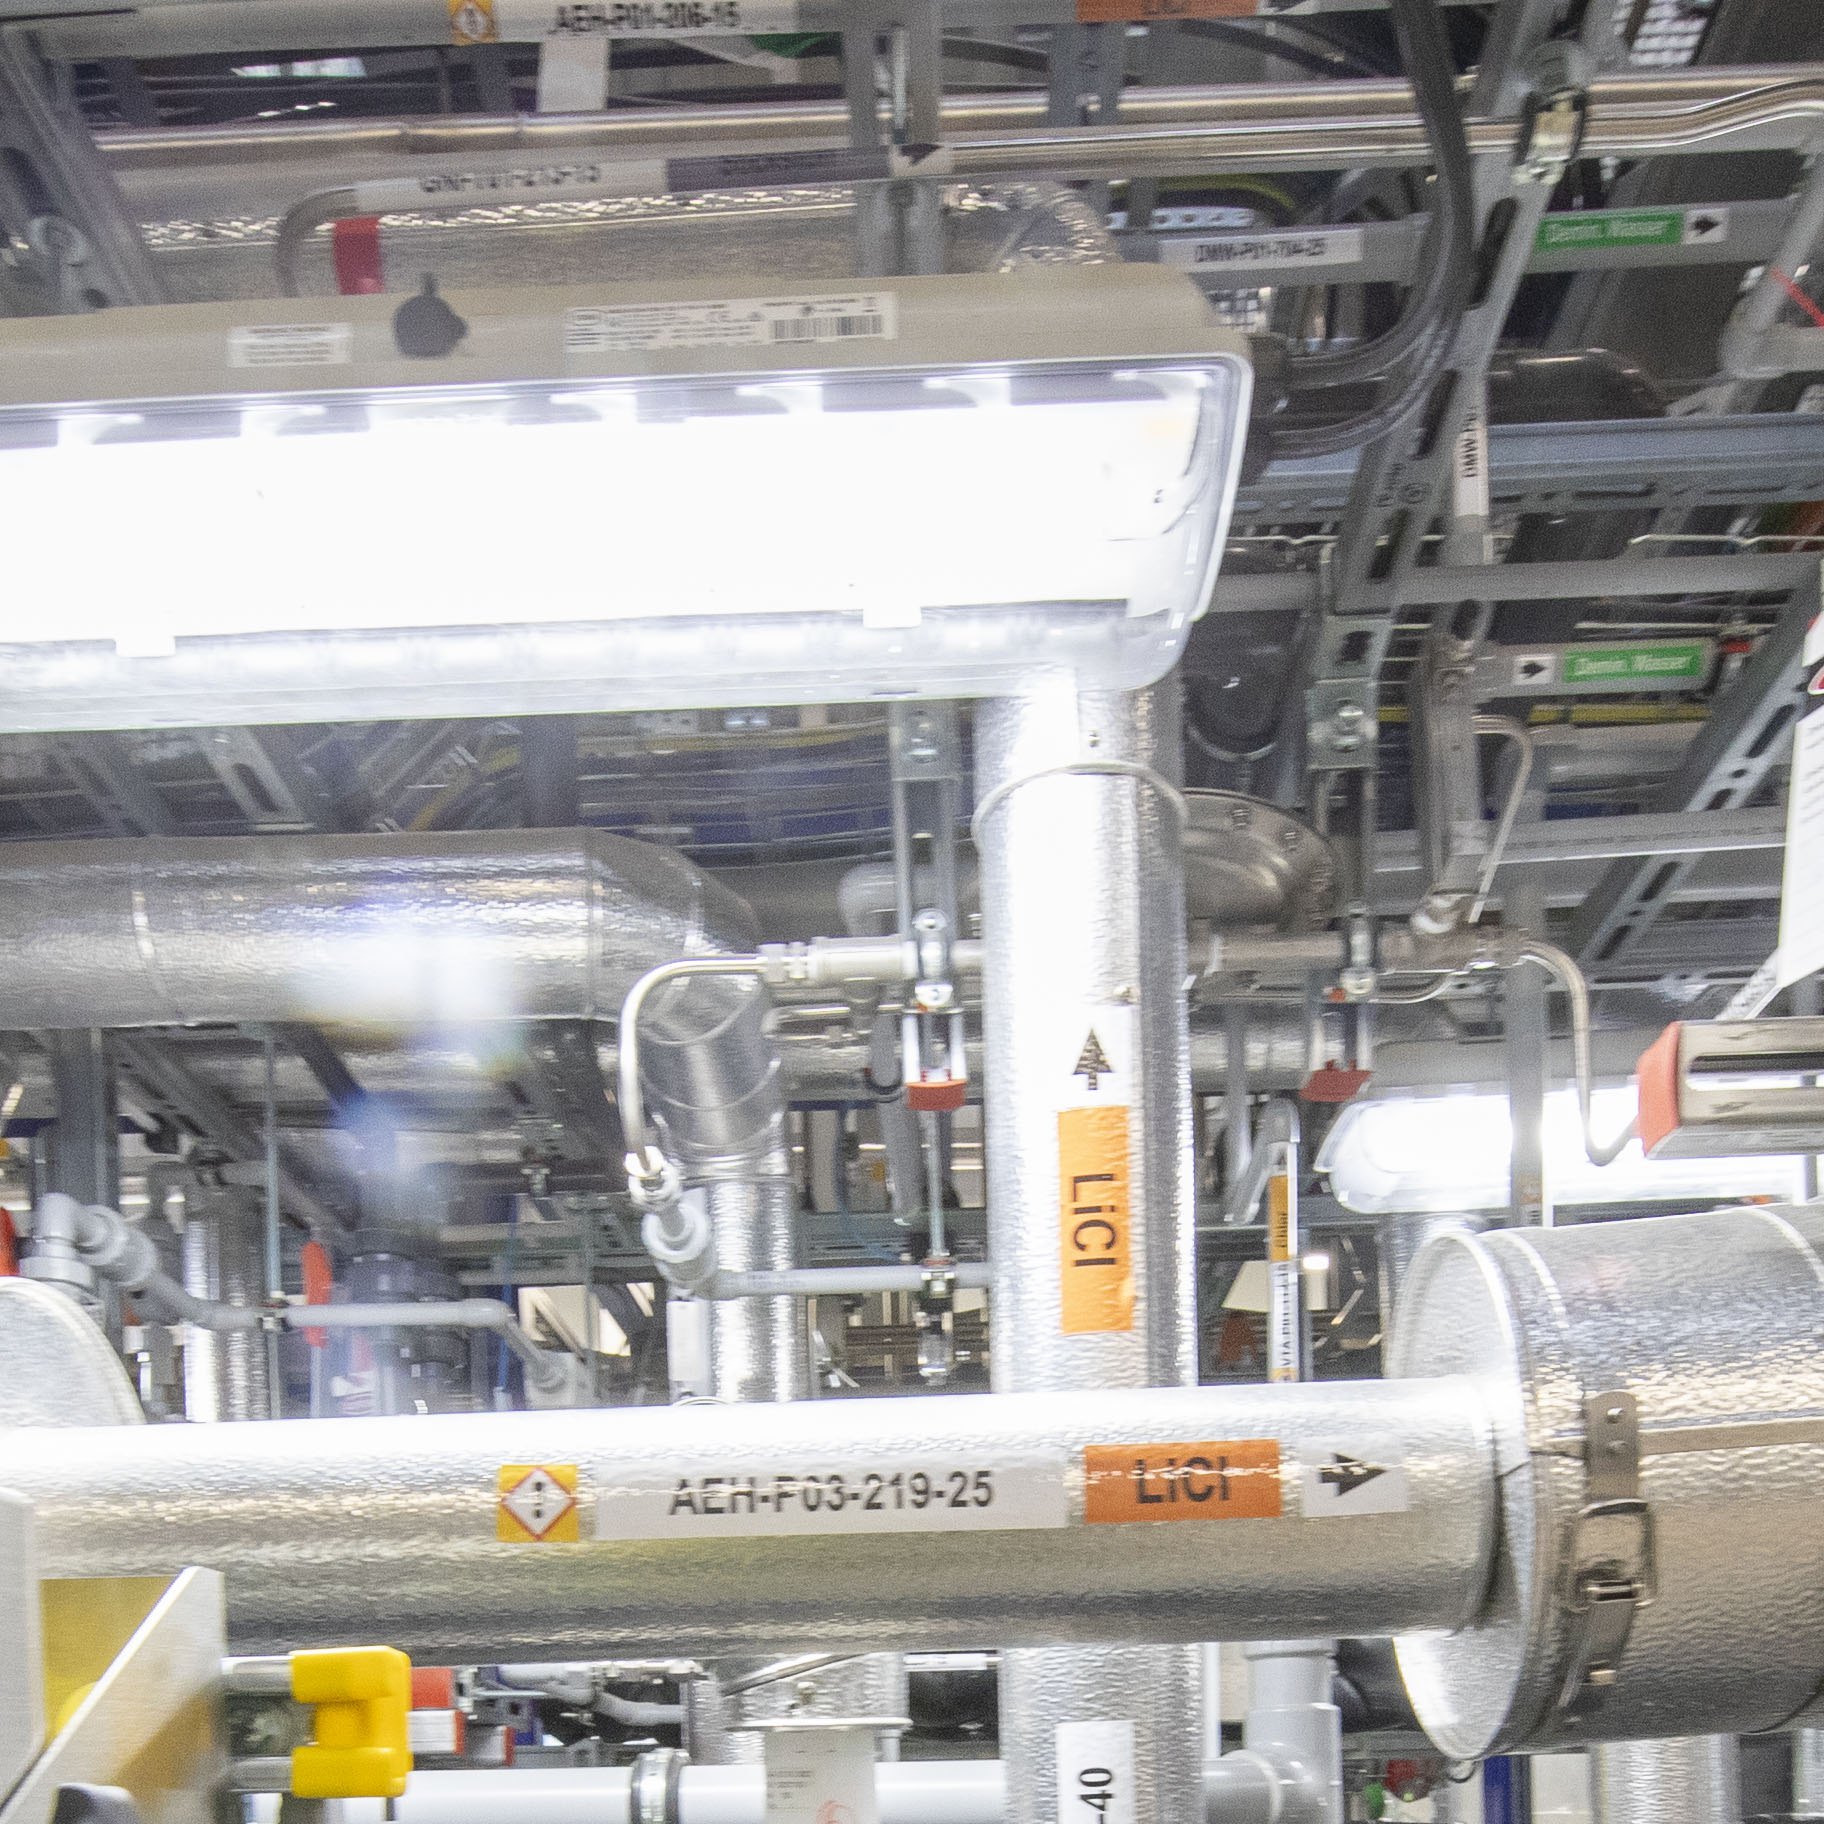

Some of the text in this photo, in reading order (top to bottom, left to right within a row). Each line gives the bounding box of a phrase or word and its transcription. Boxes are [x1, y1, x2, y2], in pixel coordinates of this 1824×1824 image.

[1070, 1171, 1118, 1270] LiCl
[667, 1468, 996, 1518] AEH-P03-219-25
[1134, 1457, 1232, 1505] LiCl
